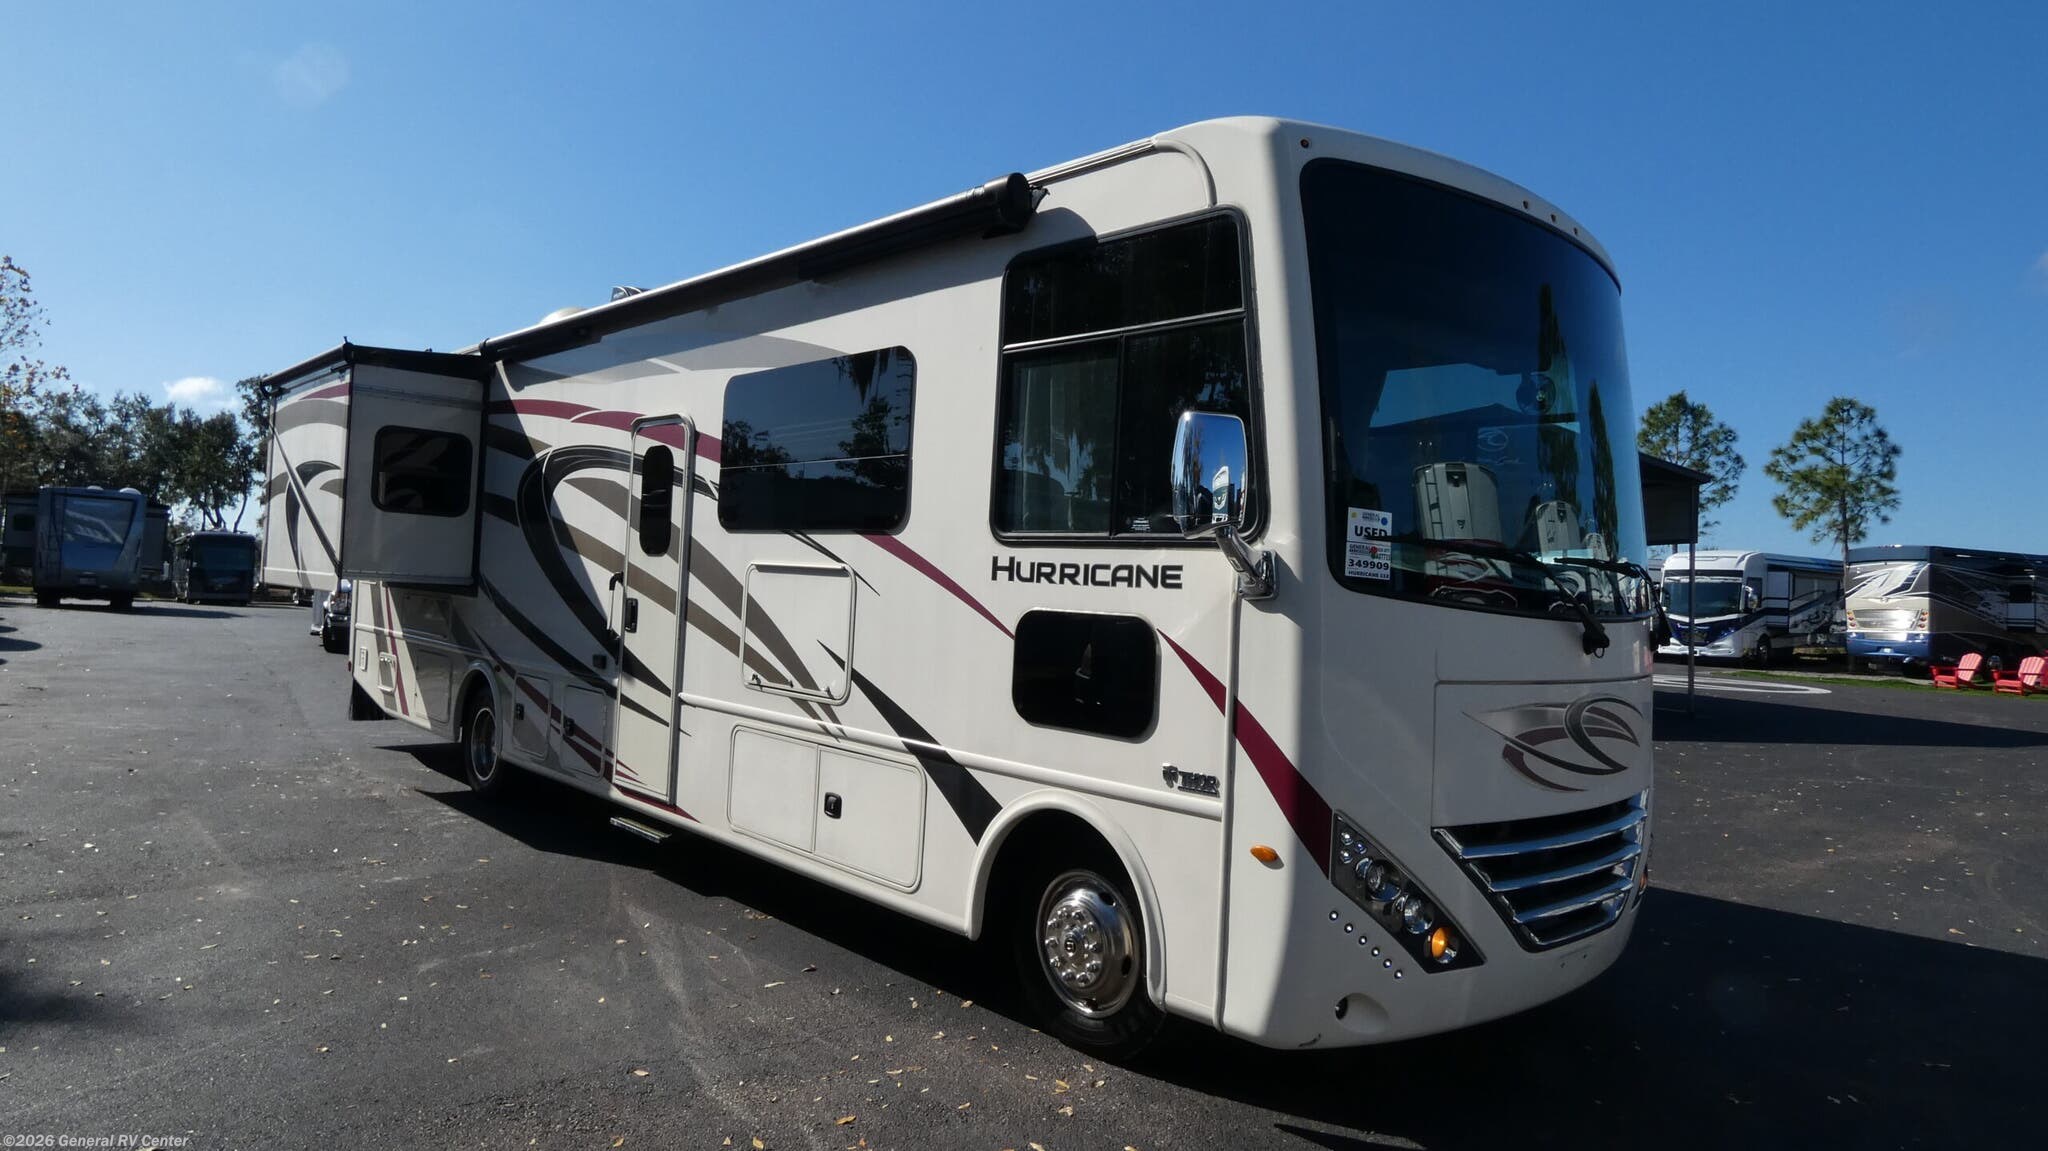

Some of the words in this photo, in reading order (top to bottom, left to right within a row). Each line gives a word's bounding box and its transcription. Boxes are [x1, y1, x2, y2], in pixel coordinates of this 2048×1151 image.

[1354, 525, 1388, 538] USED
[1348, 559, 1389, 571] 349909
[991, 556, 1183, 589] HURRICANE
